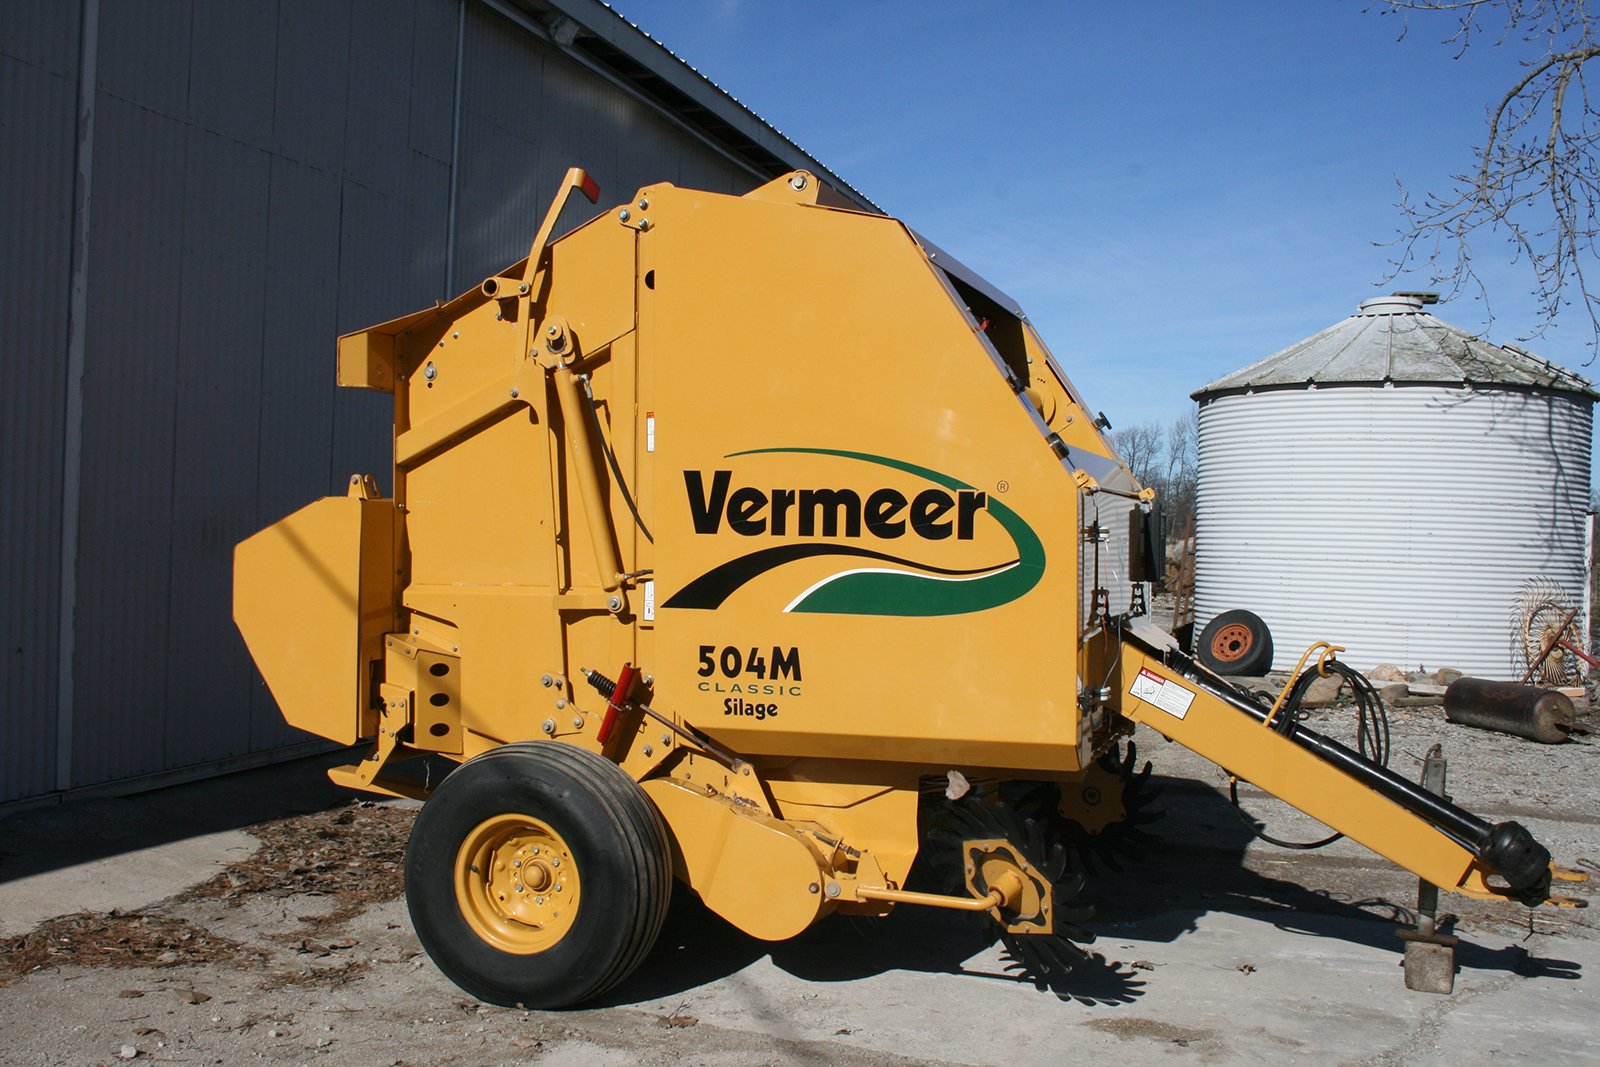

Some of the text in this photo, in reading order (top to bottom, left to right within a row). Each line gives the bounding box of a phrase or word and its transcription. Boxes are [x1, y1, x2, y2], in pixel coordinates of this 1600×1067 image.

[683, 470, 986, 540] Vermeer
[697, 645, 802, 682] 504M
[697, 682, 802, 697] CLASSIC
[1146, 672, 1164, 684] DANGER
[723, 698, 778, 721] Silage
